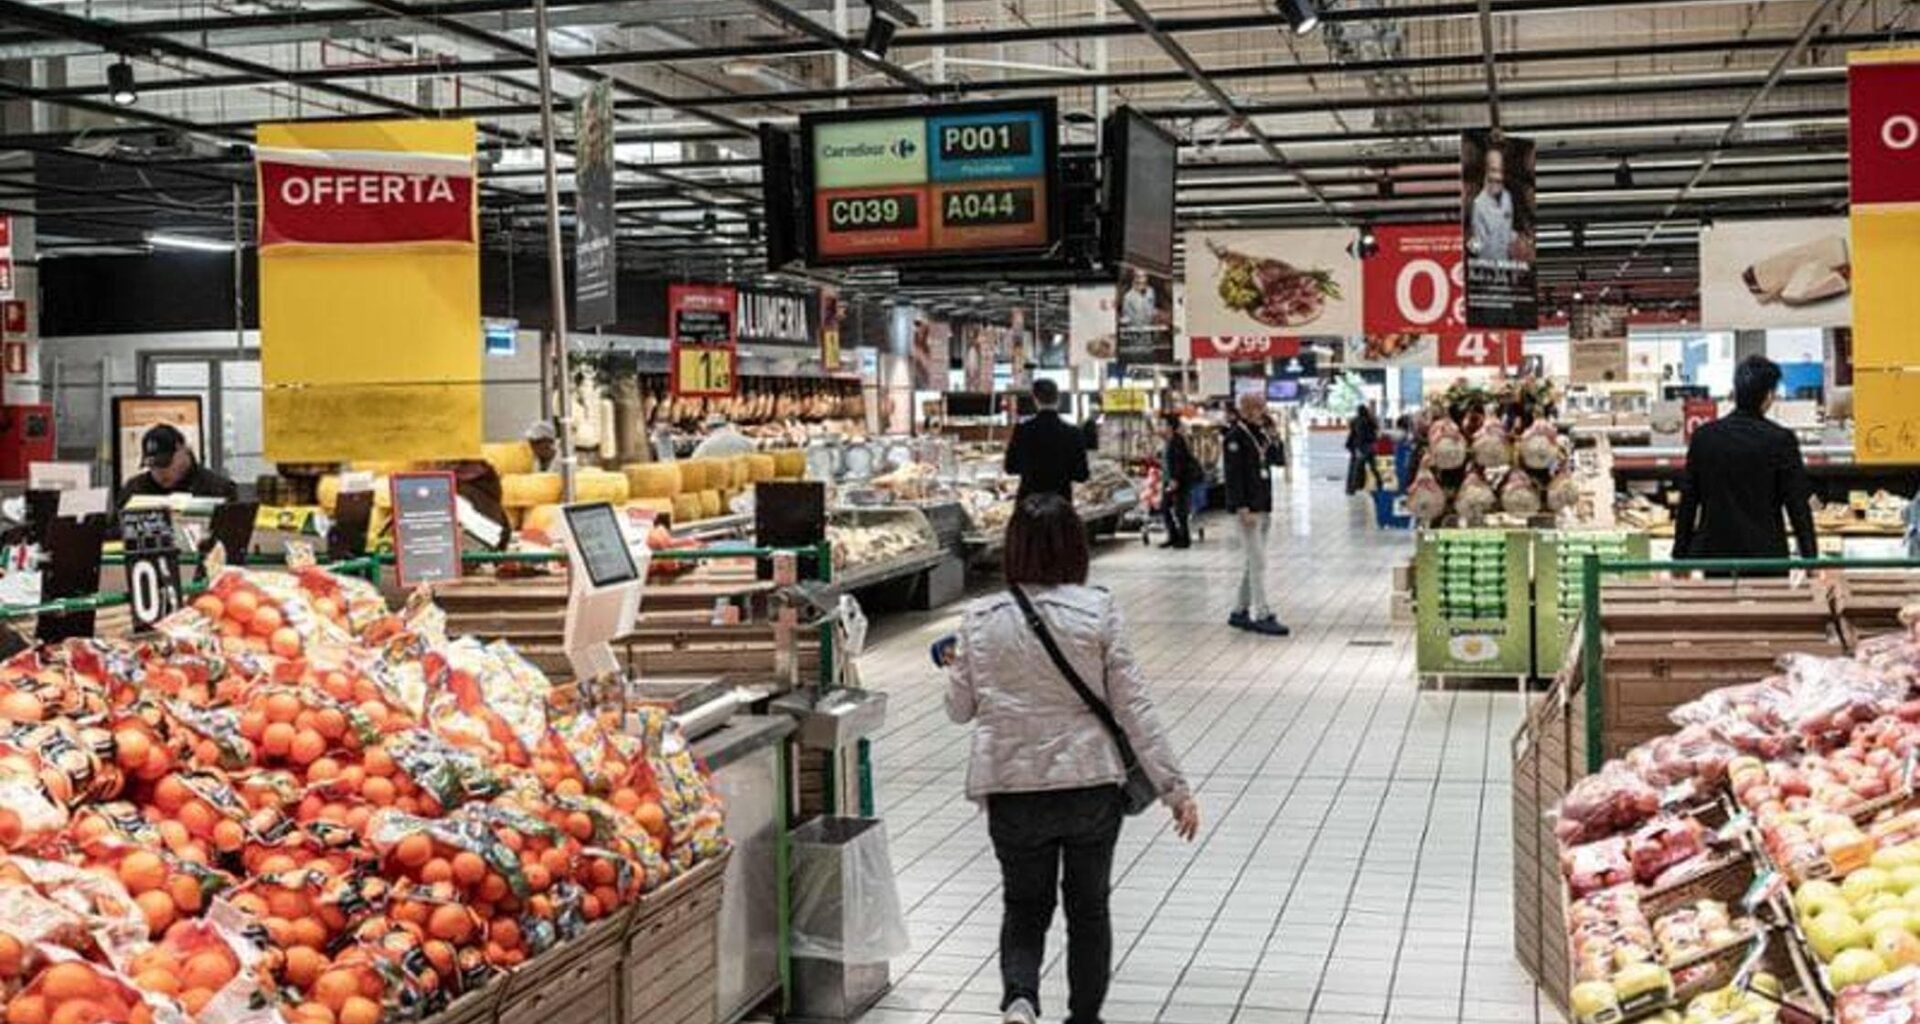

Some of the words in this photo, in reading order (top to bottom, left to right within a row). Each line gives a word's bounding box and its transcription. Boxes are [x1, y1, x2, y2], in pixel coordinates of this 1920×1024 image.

[945, 126, 1010, 151] P001
[281, 174, 455, 206] OFFERTA
[832, 198, 899, 224] C039
[947, 192, 1015, 220] A044
